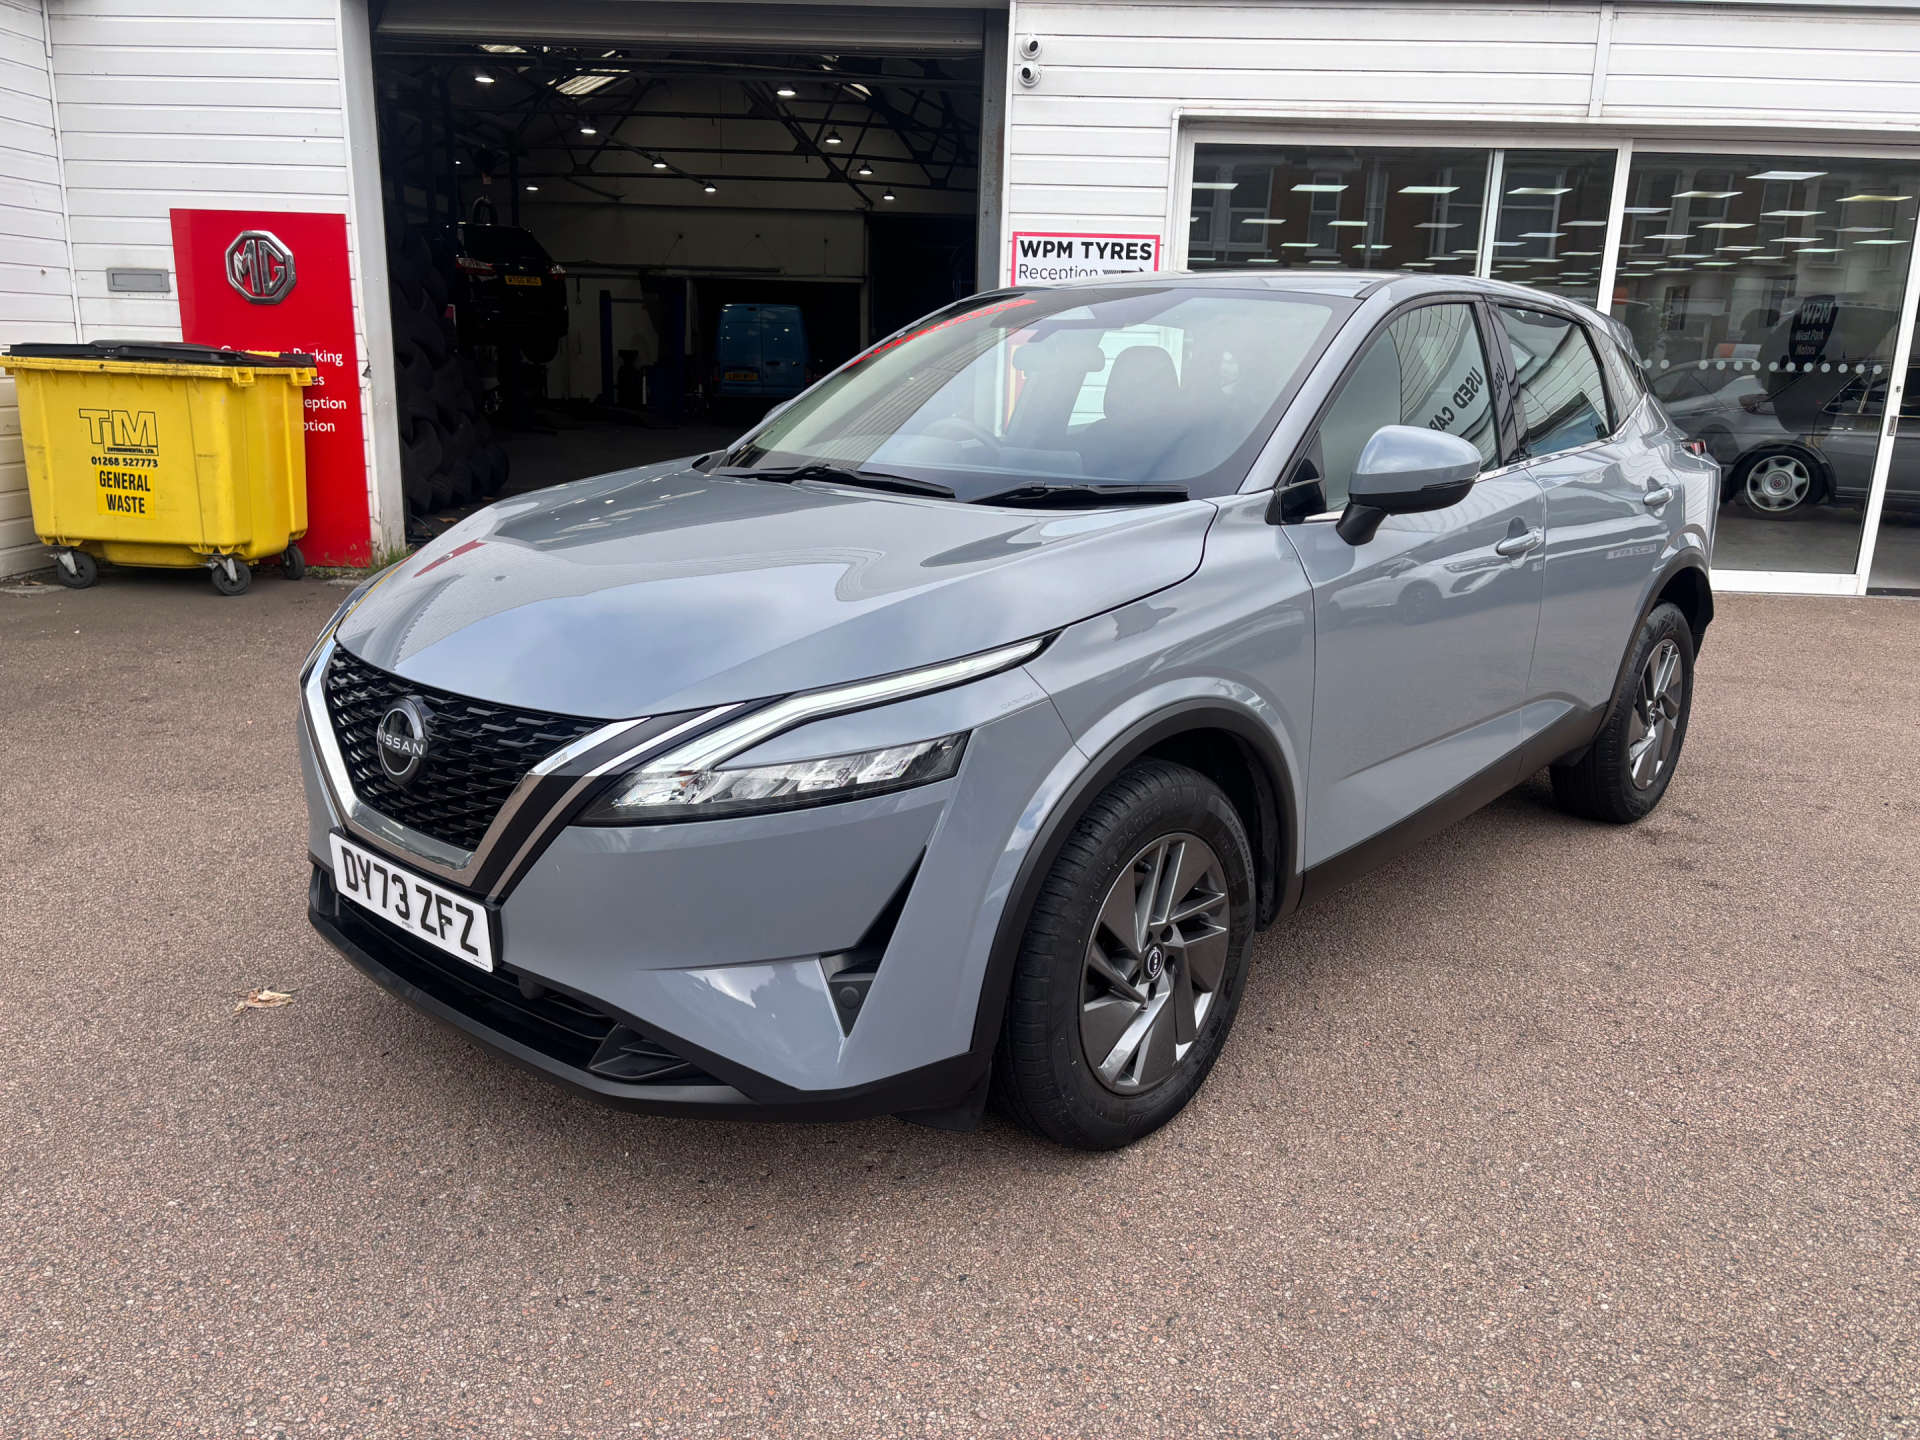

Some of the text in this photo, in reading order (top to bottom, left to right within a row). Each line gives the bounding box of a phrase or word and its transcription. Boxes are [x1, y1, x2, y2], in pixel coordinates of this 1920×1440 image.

[1019, 240, 1153, 260] WPM TYRES
[233, 239, 286, 296] MG
[1800, 302, 1834, 324] WPM
[91, 456, 159, 468] 01268 527773
[99, 470, 151, 492] GENERAL
[106, 493, 146, 514] WASTE
[377, 726, 424, 755] NISSAN
[341, 845, 479, 957] DY73 ZFZ
